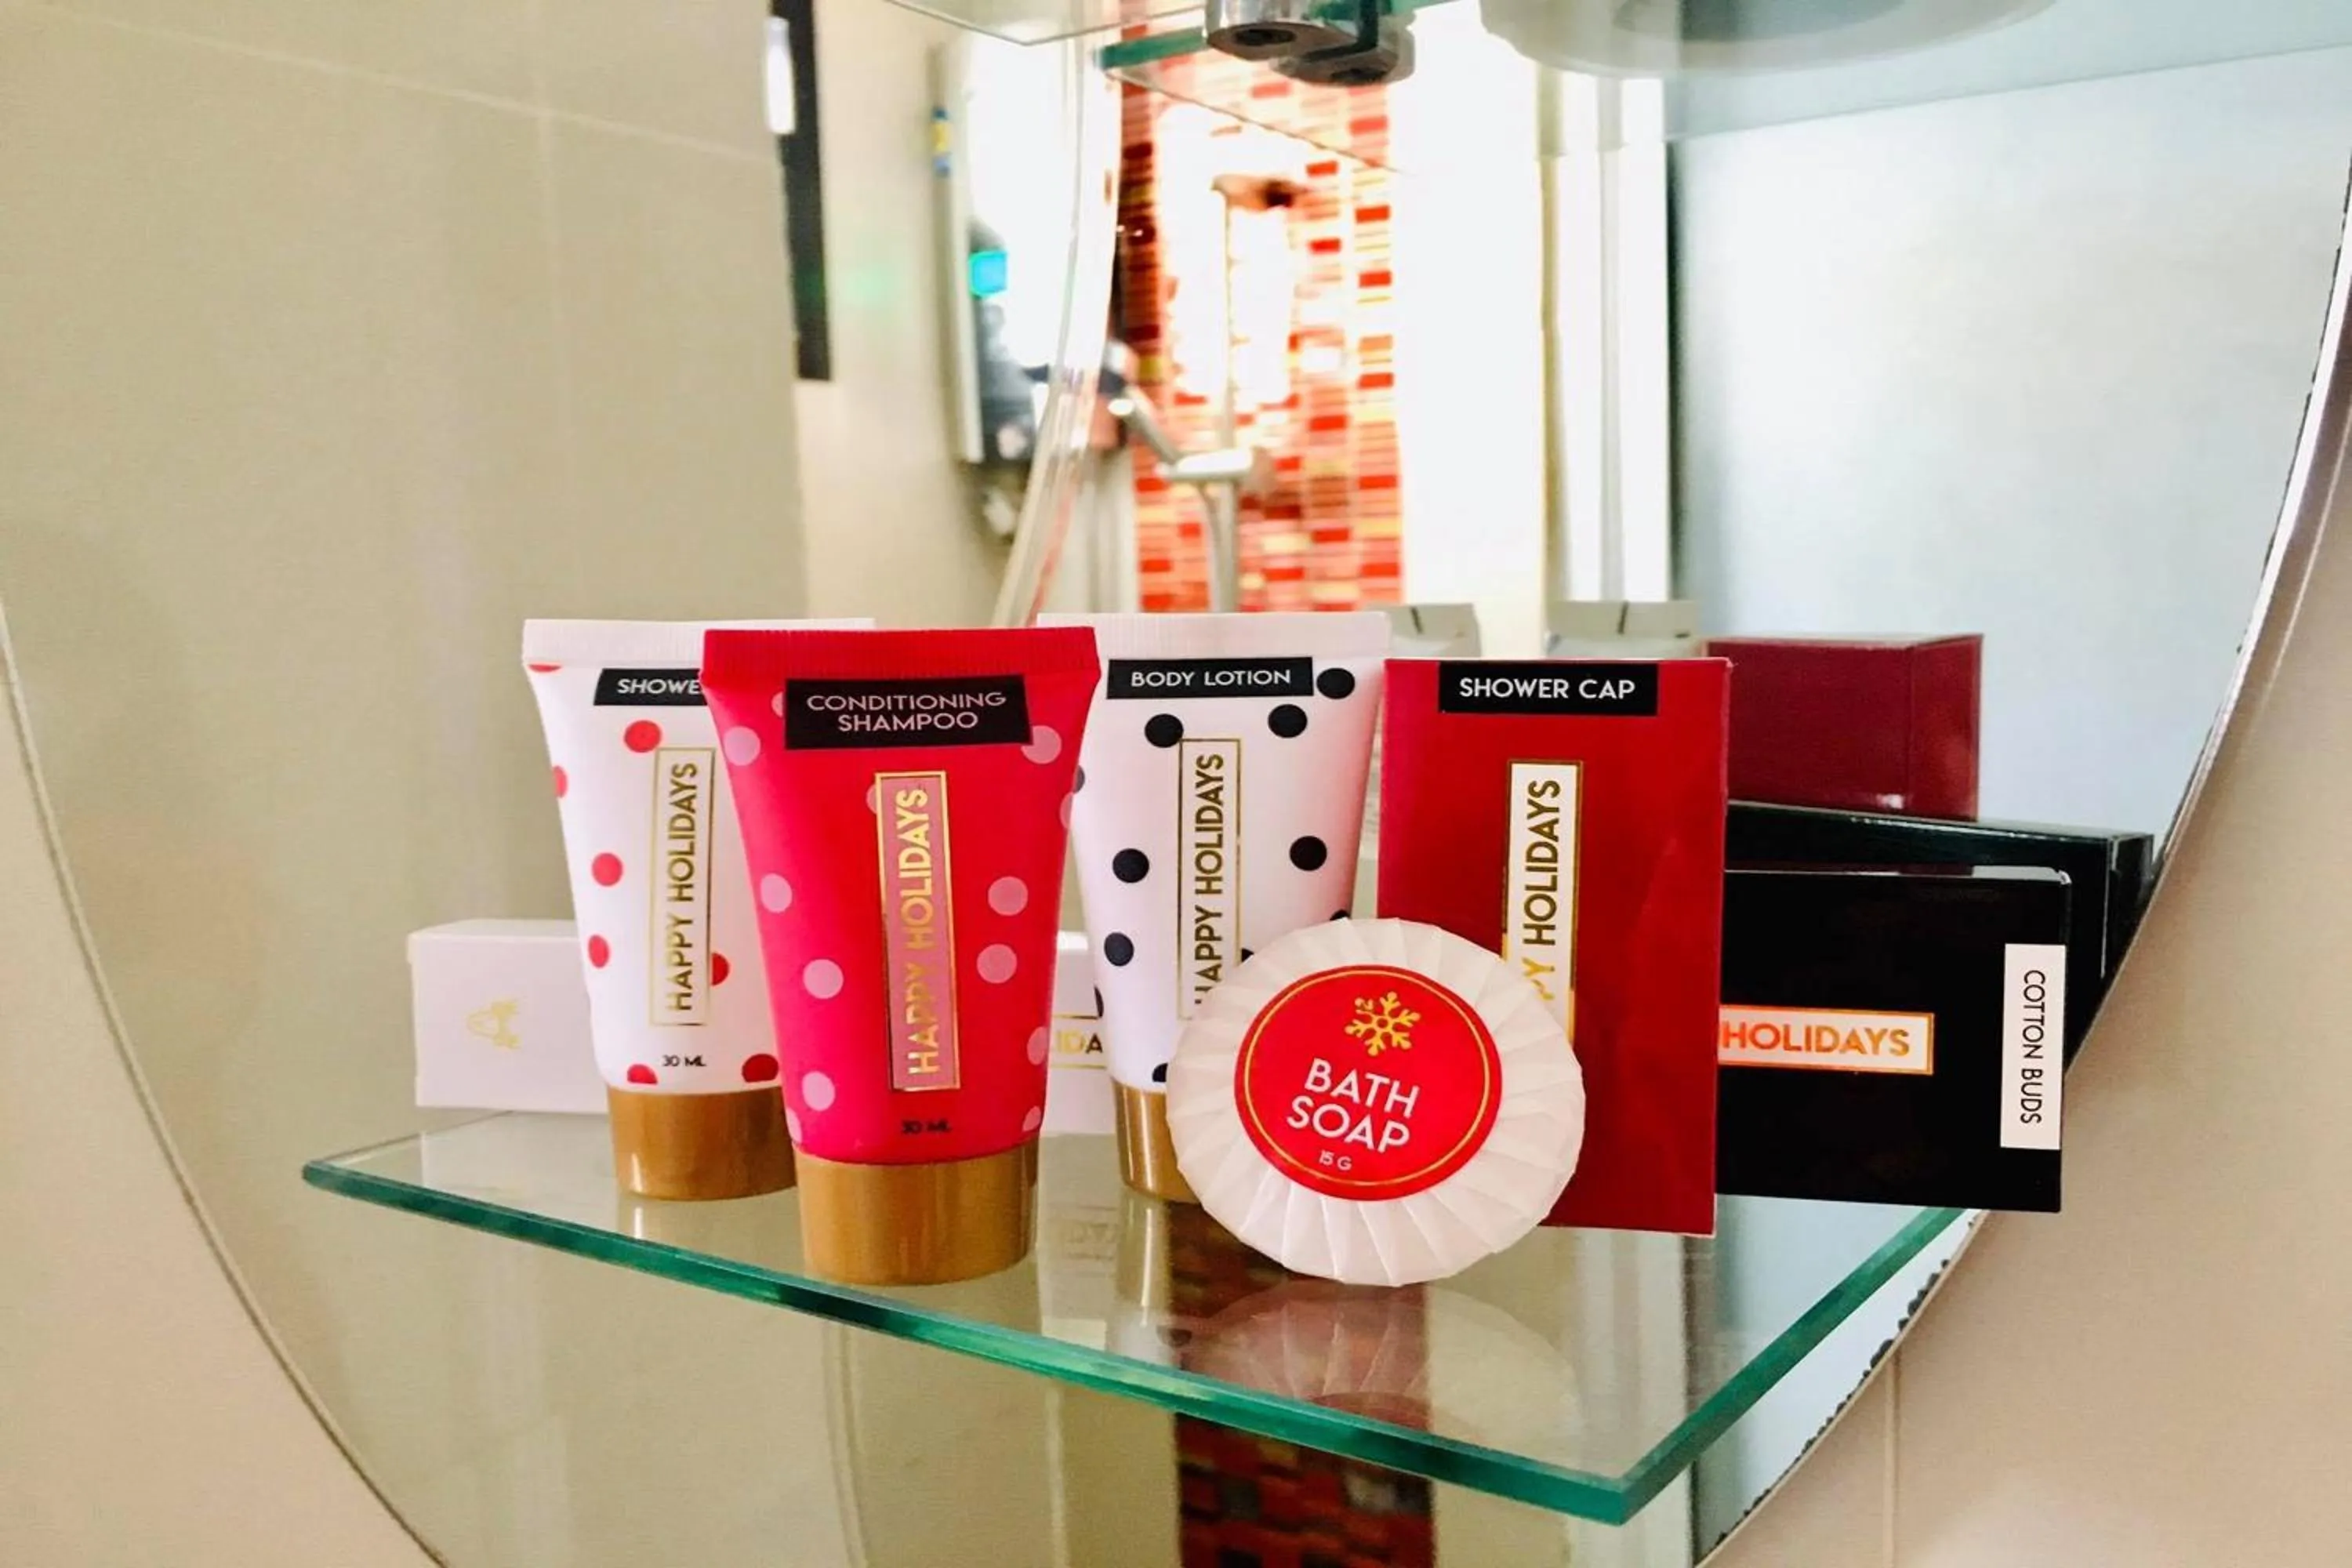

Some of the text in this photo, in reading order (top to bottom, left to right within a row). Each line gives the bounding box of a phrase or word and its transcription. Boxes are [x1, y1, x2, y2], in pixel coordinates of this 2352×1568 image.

[616, 678, 702, 695] SHOWE
[1131, 669, 1291, 687] BODY LOTION
[1459, 677, 1635, 699] SHOWER CAP
[807, 691, 1007, 711] CONDITIONING
[837, 712, 978, 732] SHAMPOO
[1194, 753, 1225, 895] HOLIDAYS
[1522, 779, 1561, 946] HOLIDAYS
[666, 762, 698, 1011] HAPPY HOLIDAYS
[895, 788, 939, 1075] HAPPY HOLIDAYS
[1721, 1021, 1911, 1057] HOLIDAYS
[2020, 969, 2046, 1124] COTTON BUDS
[662, 1054, 708, 1067] 30 ML
[1304, 1057, 1421, 1120] BATH
[1286, 1094, 1411, 1154] SOAP
[1319, 1149, 1353, 1171] 15 G
